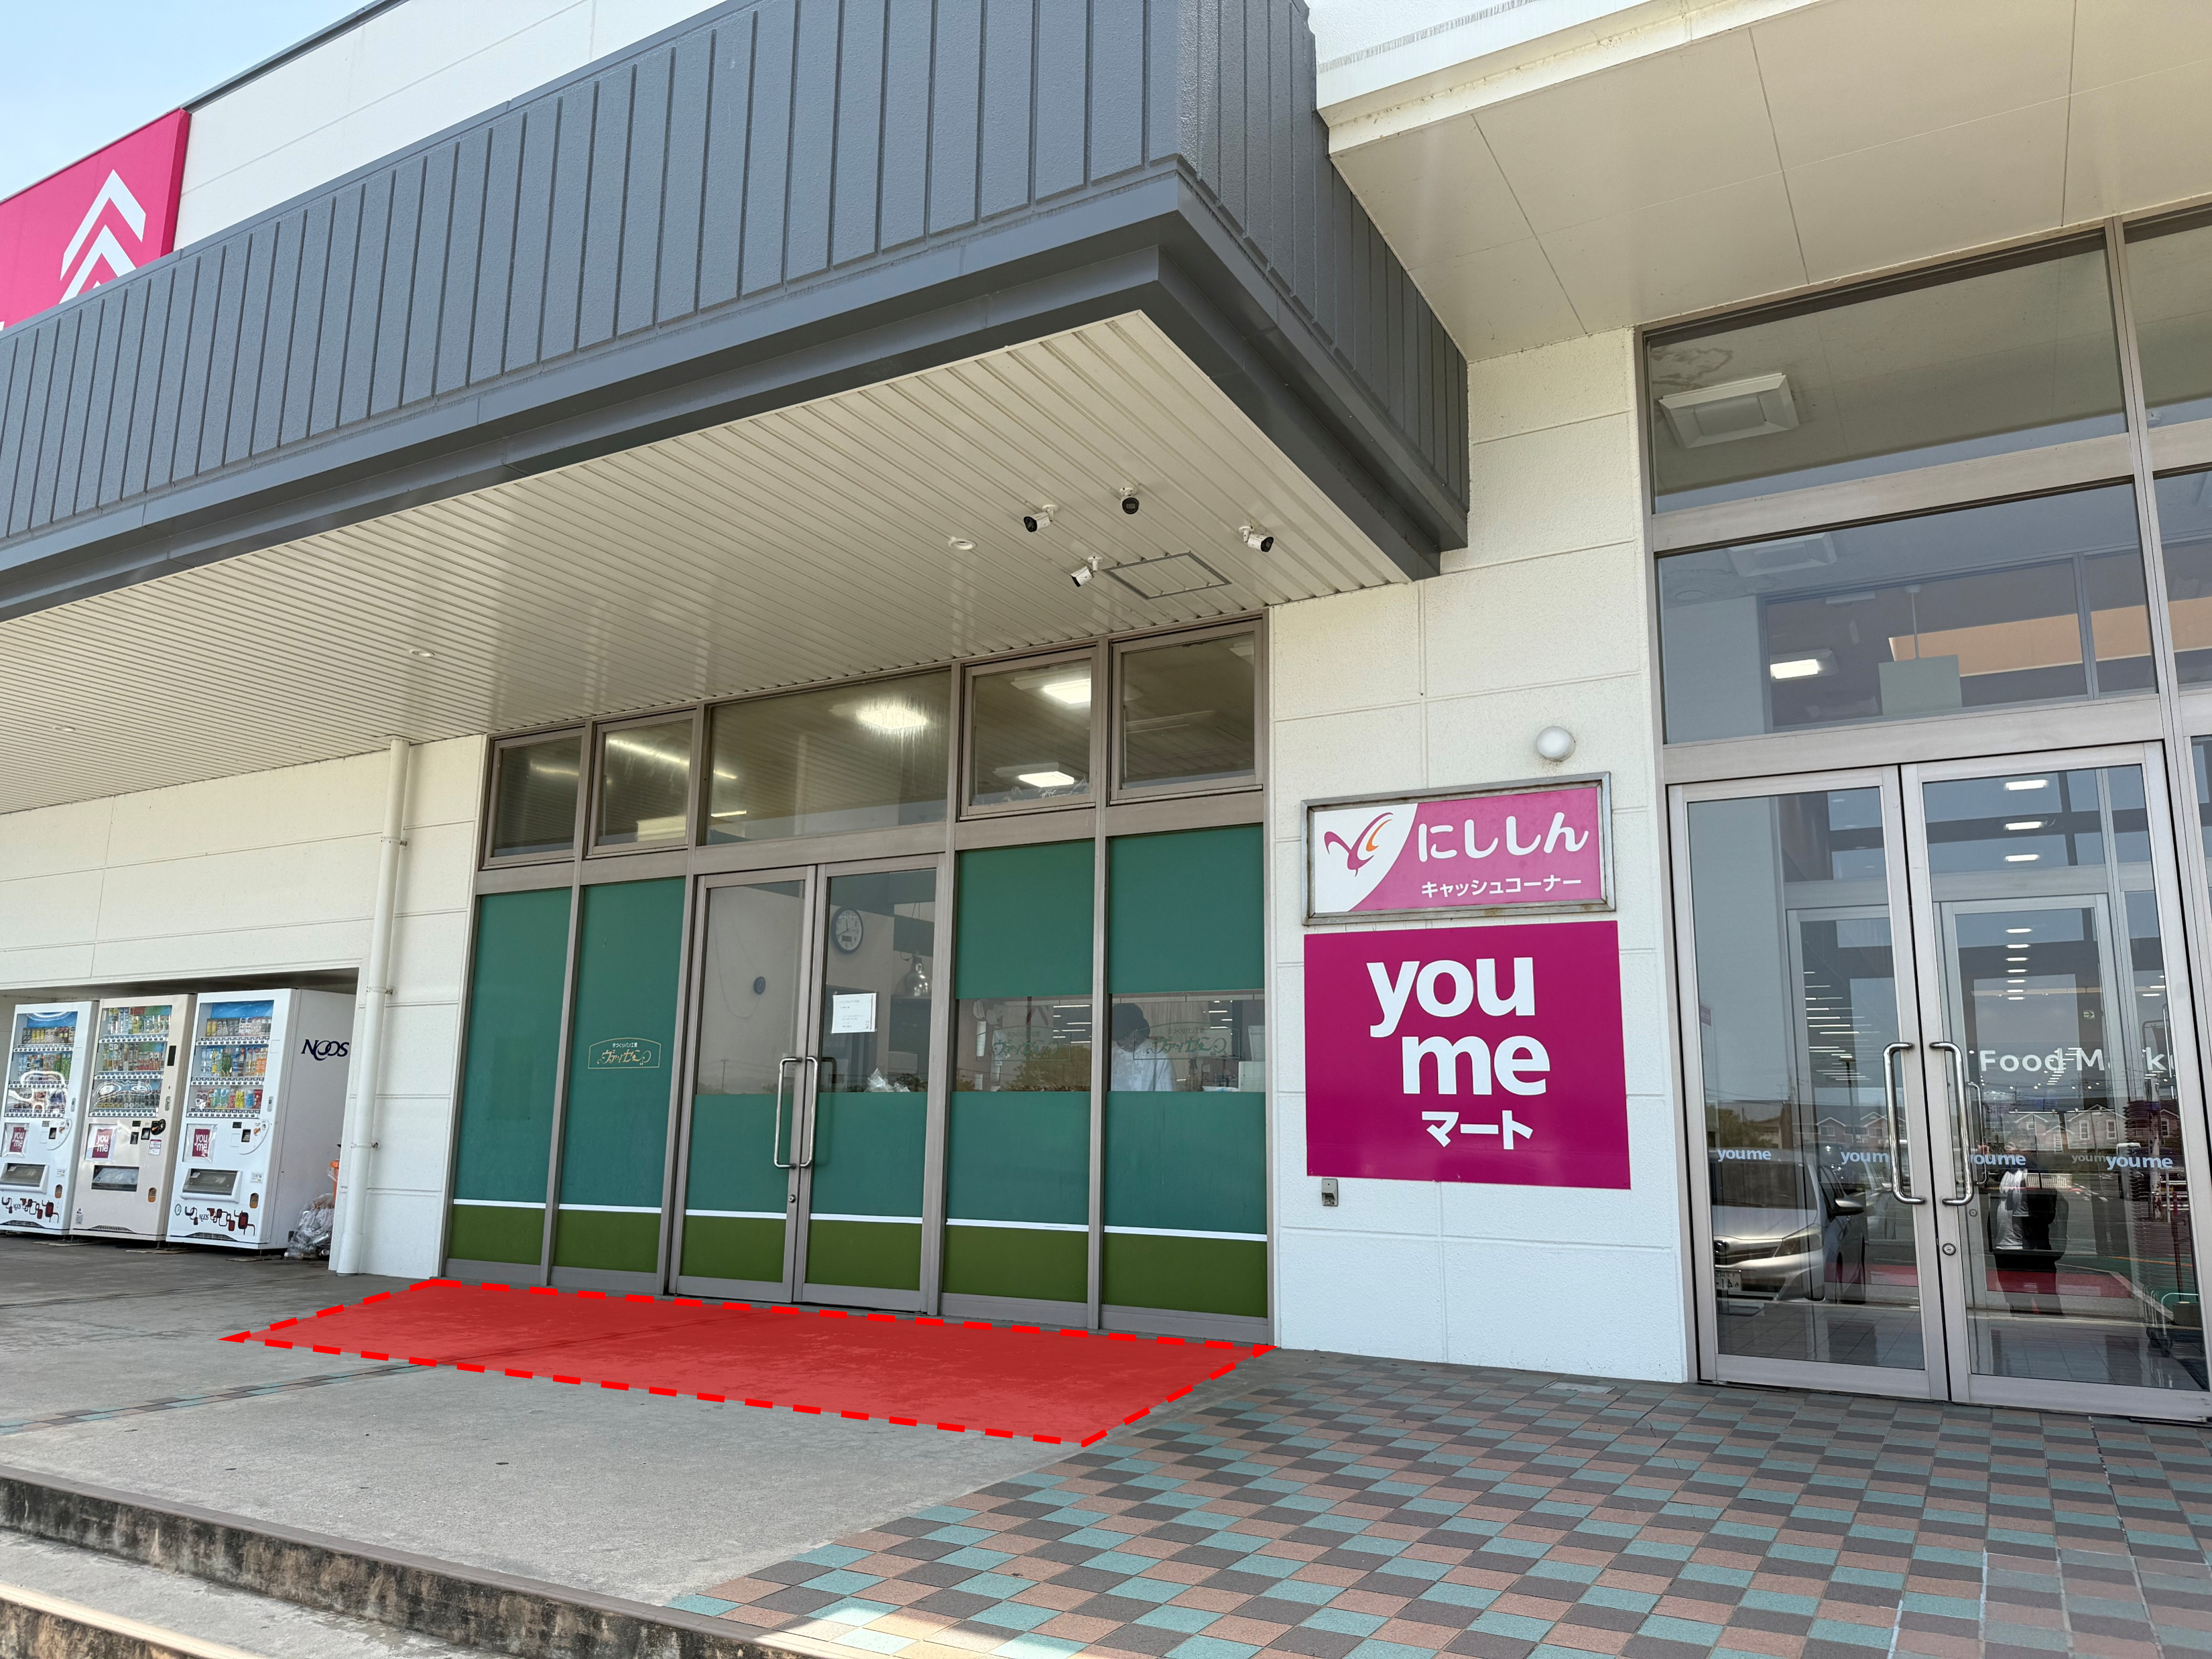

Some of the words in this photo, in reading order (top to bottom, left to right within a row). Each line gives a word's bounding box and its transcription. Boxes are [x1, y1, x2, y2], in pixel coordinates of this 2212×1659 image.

[1418, 812, 1589, 862] にししん
[1421, 874, 1582, 898] キャッシュコーナー
[1366, 957, 1536, 1038] you
[1402, 1036, 1550, 1096] me
[1979, 1047, 2064, 1072] Food
[12, 1131, 24, 1142] you
[1422, 1110, 1533, 1150] マート
[13, 1140, 23, 1148] me
[97, 1134, 110, 1145] you
[194, 1133, 208, 1146] you
[97, 1144, 109, 1152] me
[196, 1143, 208, 1152] me
[1840, 1151, 1890, 1165] youm
[2071, 1154, 2107, 1164] youm
